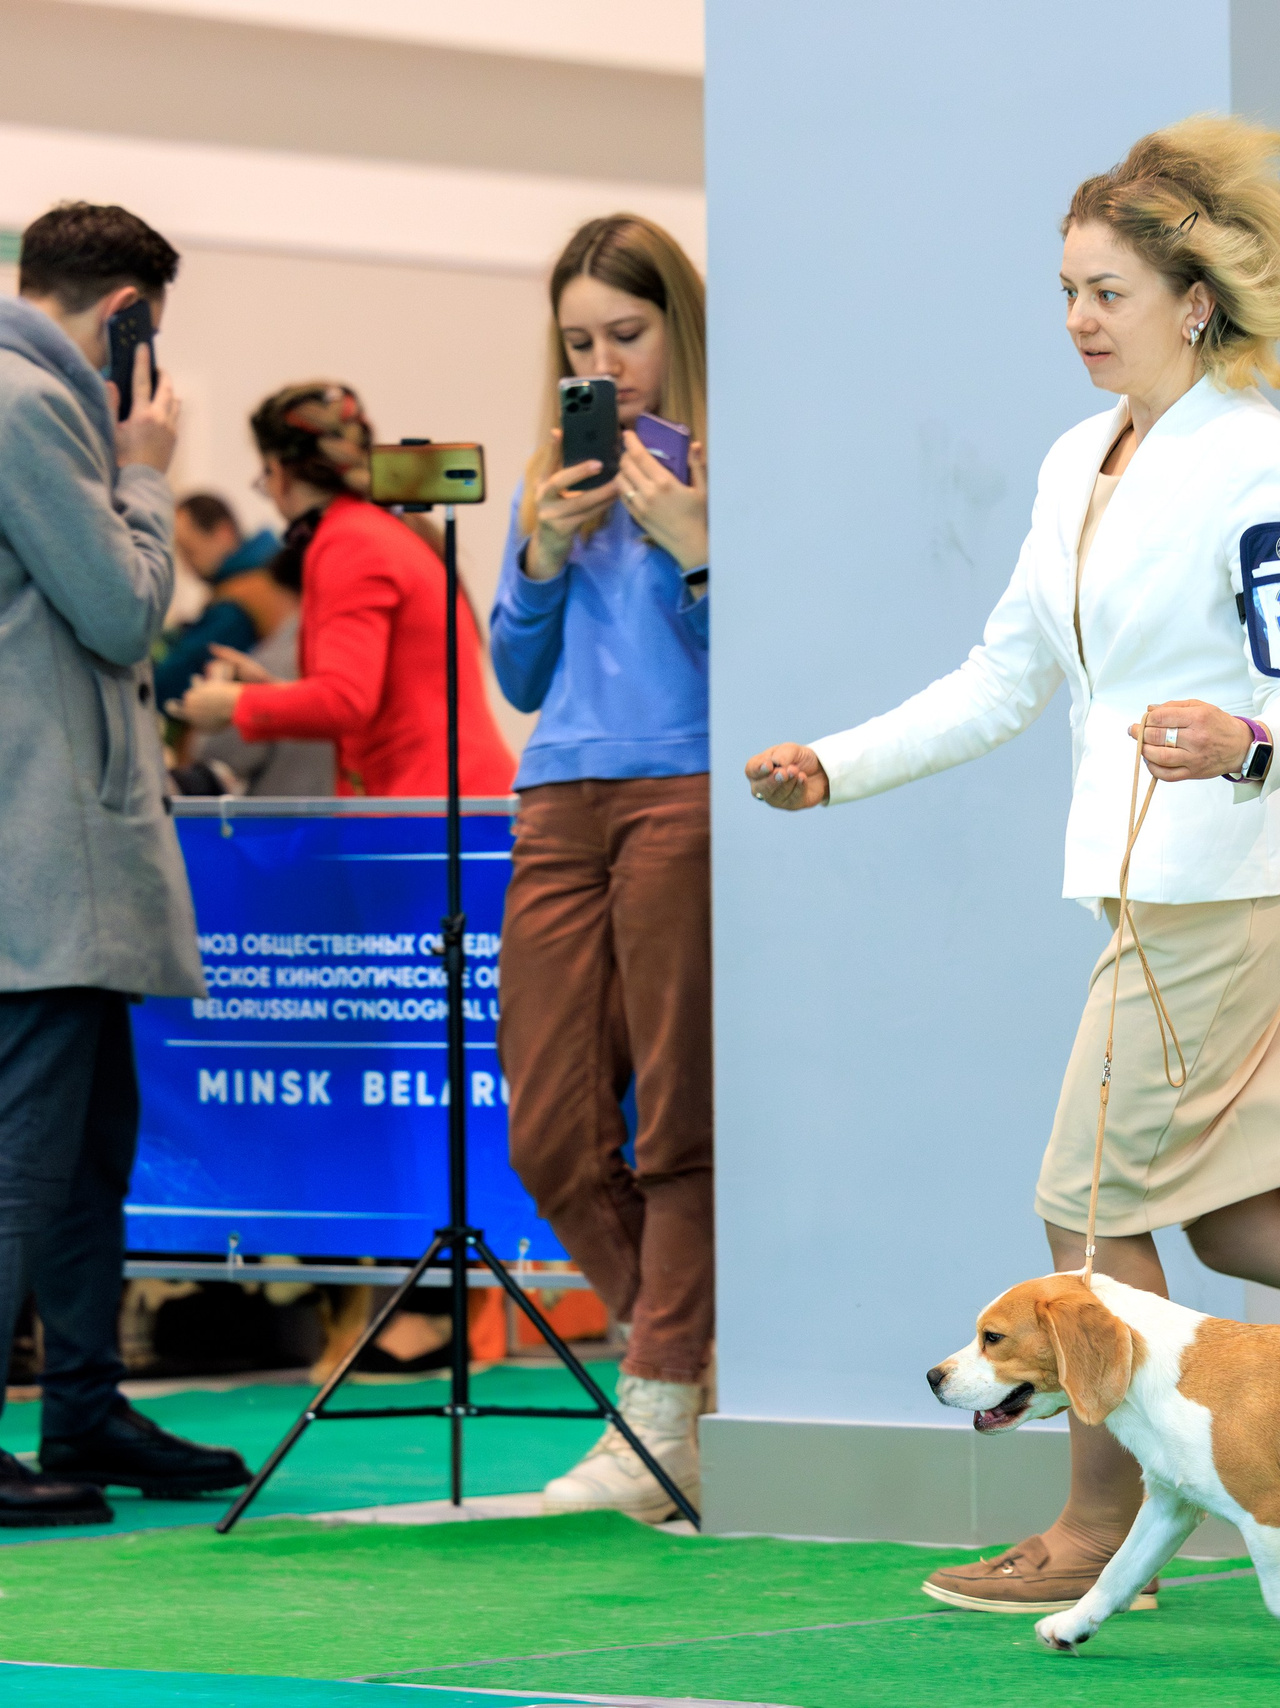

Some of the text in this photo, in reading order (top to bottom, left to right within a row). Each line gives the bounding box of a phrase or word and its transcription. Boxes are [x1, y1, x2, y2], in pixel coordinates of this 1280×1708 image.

[242, 933, 416, 957] ОБЩЕСТВЕННЫХ
[202, 966, 271, 988] ССКОЕ
[192, 998, 329, 1021] BELORUSSIAN
[198, 1068, 332, 1106] MINSK
